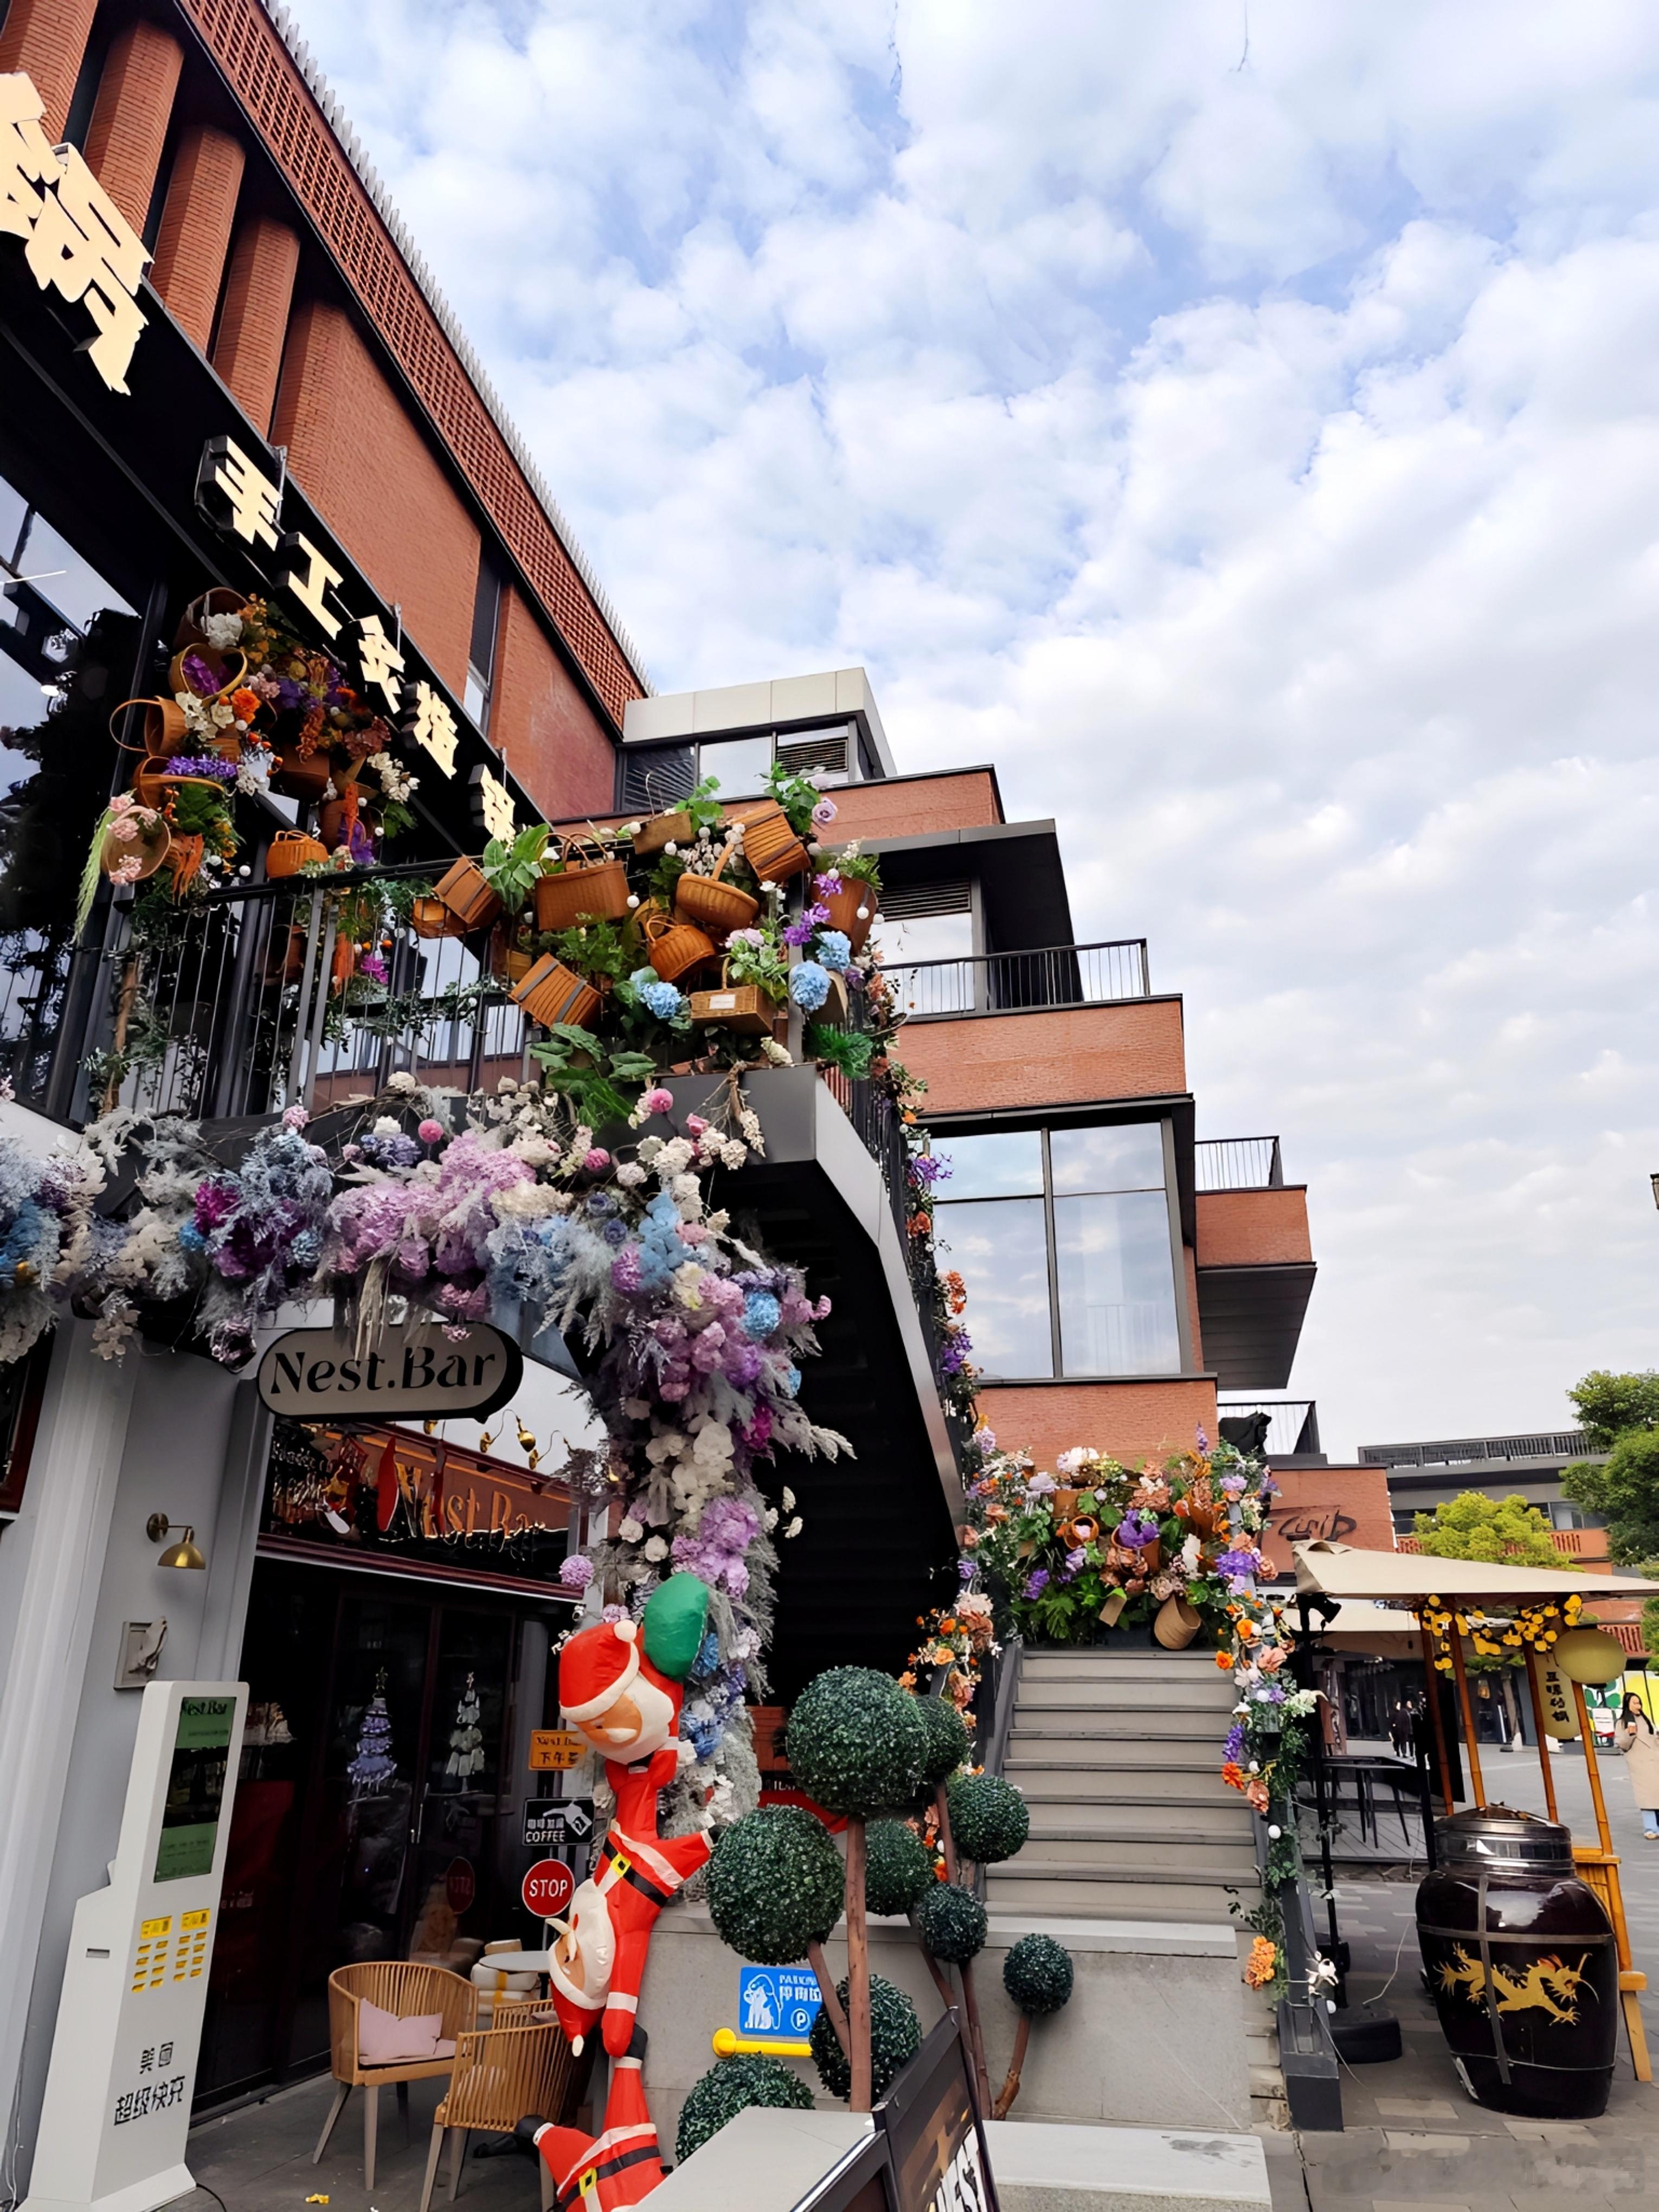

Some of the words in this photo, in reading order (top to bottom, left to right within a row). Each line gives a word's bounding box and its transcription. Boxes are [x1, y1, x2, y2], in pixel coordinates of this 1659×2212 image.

[271, 1346, 496, 1394] Nest.Bar
[525, 1830, 565, 1843] COFFEE
[529, 1879, 568, 1898] STOP
[114, 2075, 185, 2126] 超级快充
